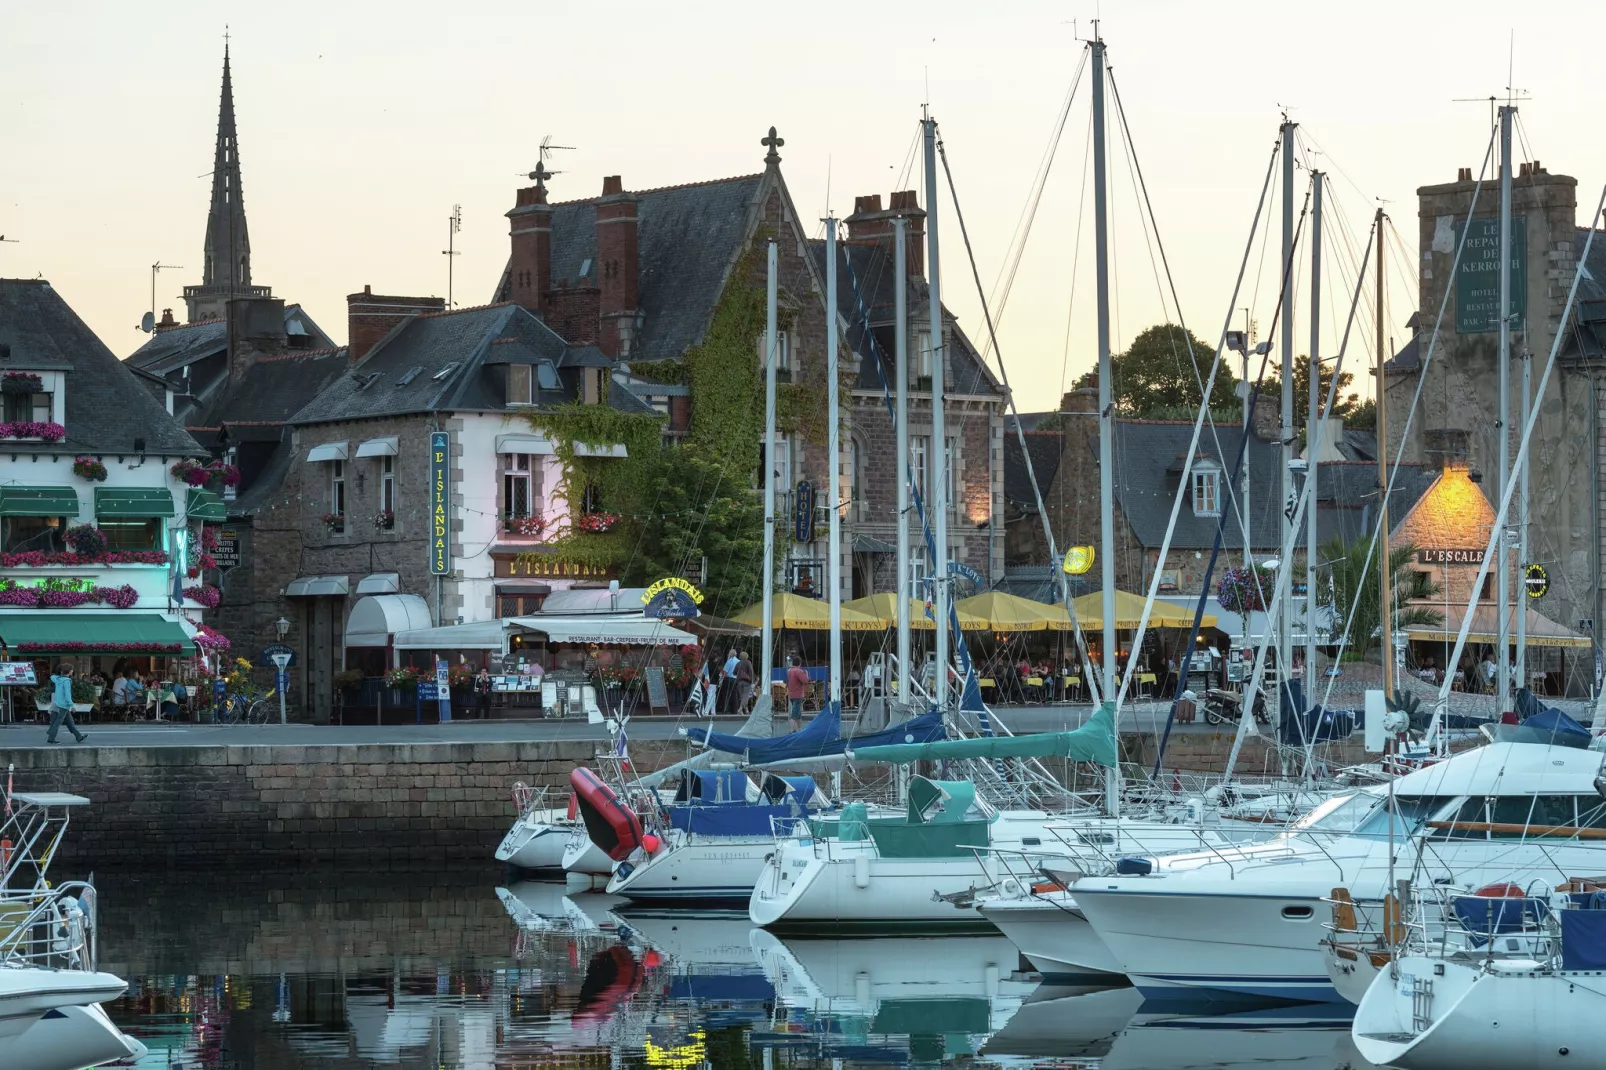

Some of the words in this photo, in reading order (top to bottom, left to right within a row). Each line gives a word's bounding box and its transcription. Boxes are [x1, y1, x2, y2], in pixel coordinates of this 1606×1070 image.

[1483, 225, 1498, 236] LE
[1483, 249, 1498, 259] DE
[1462, 259, 1520, 273] KERROH
[1466, 300, 1516, 312] RESTAURT
[1463, 317, 1479, 326] BAR
[800, 491, 808, 540] HOTEL
[1424, 549, 1485, 562] L'ESCALE
[640, 577, 705, 606] L'ISLANDAIS
